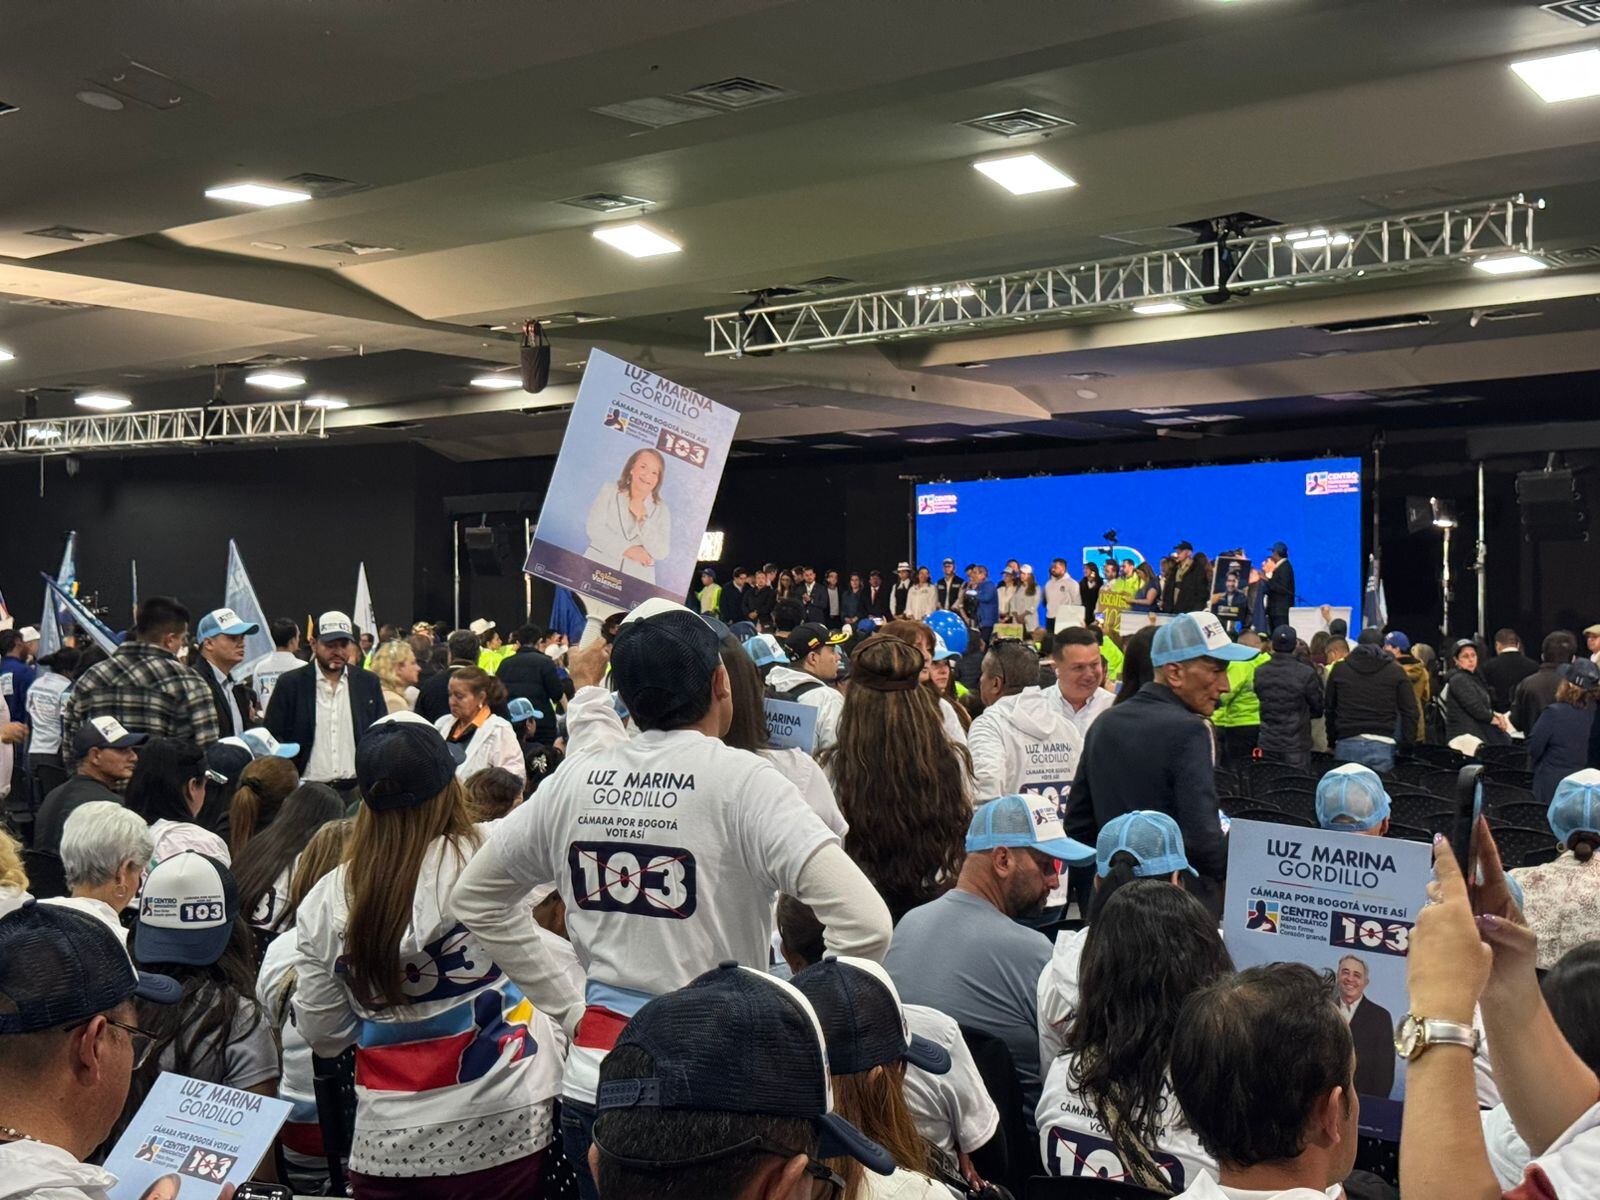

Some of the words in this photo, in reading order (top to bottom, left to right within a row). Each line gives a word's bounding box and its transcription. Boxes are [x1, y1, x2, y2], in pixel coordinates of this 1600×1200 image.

[624, 364, 652, 384] LUZ
[656, 378, 713, 413] MARINA
[630, 382, 700, 419] GORDILLO
[629, 416, 660, 433] CENTRO
[664, 432, 706, 465] 103
[768, 723, 793, 736] DILLO
[1025, 744, 1040, 754] LUZ
[1031, 753, 1070, 764] GORDILLO
[587, 770, 618, 786] LUZ
[623, 772, 696, 790] MARINA
[593, 788, 678, 808] GORDILLO
[578, 813, 614, 826] CÁMARA
[616, 817, 636, 827] POR
[637, 819, 679, 831] BOGOTÁ
[605, 828, 628, 838] VOTE
[629, 828, 646, 840] ASÍ
[1267, 839, 1303, 860] LUZ
[1311, 845, 1397, 873] MARINA
[577, 850, 689, 910] 103
[1278, 860, 1379, 889] GORDILLO
[185, 903, 222, 920] 103
[1250, 886, 1293, 901] CÁMARA
[1294, 893, 1315, 904] POR
[1317, 896, 1360, 911] BOGOTÁ
[1362, 904, 1389, 916] VOTE
[1390, 907, 1408, 918] ASÍ
[1280, 915, 1329, 928] DEMOCRÁTICO
[1281, 905, 1329, 921] CENTRO
[1279, 929, 1305, 939] Corazón
[1306, 932, 1327, 942] grande
[1280, 923, 1297, 931] Mano
[1341, 917, 1409, 951] 103
[180, 1079, 209, 1098] LUZ
[207, 1086, 264, 1113] MARINA
[179, 1098, 244, 1126] GORDILLO
[153, 1125, 177, 1137] CÁMARA
[176, 1130, 189, 1142] POR
[189, 1133, 214, 1148] BOGOTÁ
[162, 1139, 191, 1153] CENTRO
[187, 1150, 232, 1180] 103
